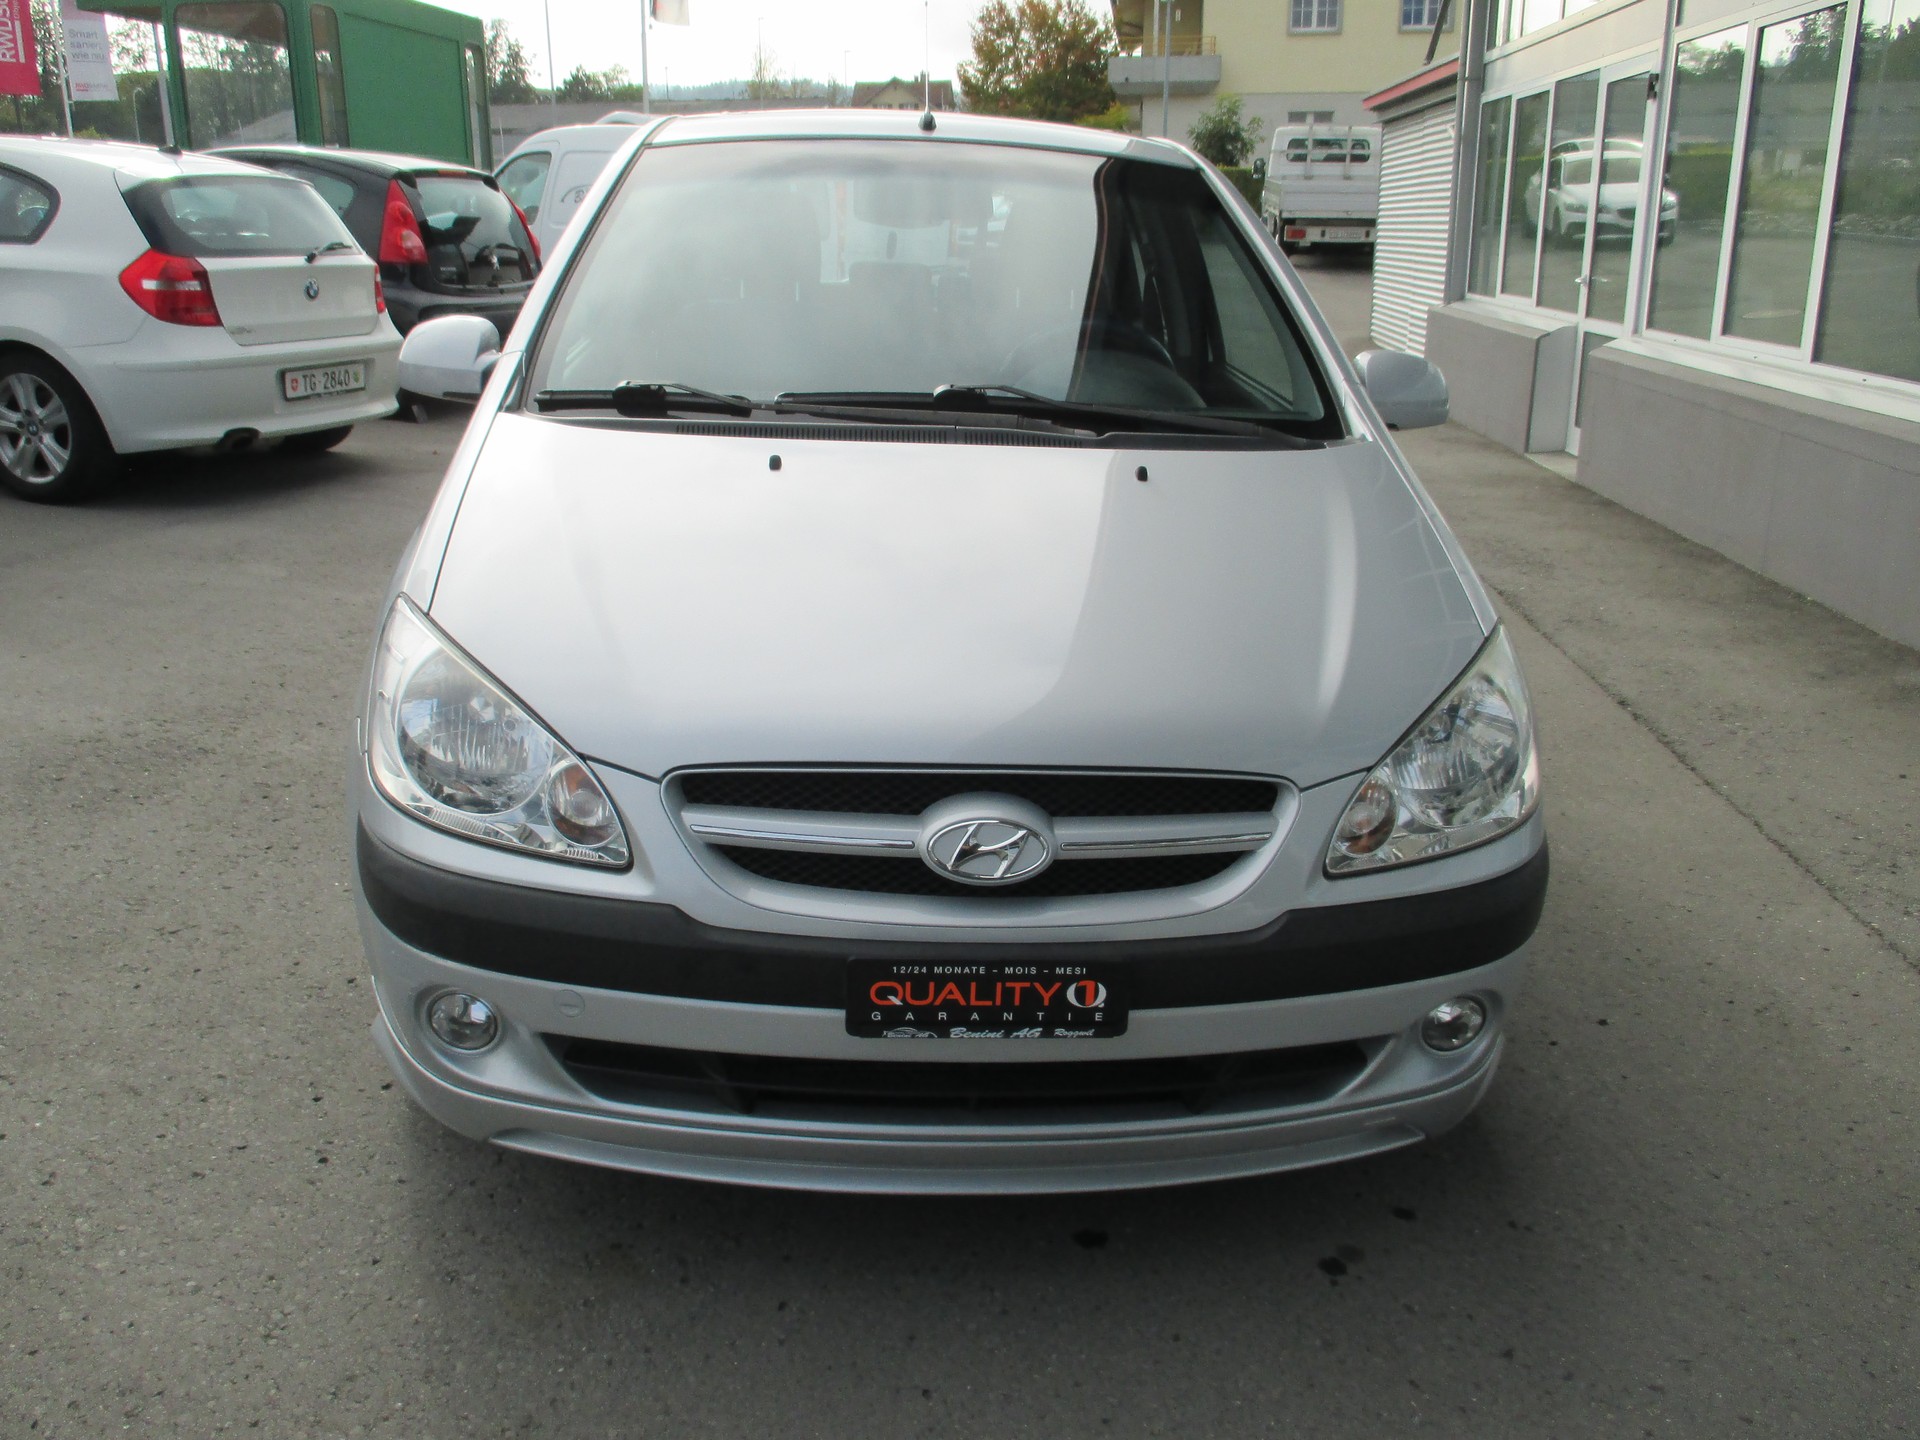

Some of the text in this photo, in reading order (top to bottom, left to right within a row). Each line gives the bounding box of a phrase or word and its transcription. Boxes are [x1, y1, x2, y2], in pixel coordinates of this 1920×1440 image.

[0, 0, 16, 62] RWDS
[68, 28, 98, 39] Smart
[302, 369, 350, 392] TG 2840
[892, 966, 927, 974] 12/24
[934, 966, 986, 974] MONATE
[1004, 966, 1037, 974] MOIS
[1055, 967, 1086, 975] MESI
[869, 981, 1062, 1006] QUALITY
[871, 1012, 1103, 1021] GARANTIE
[949, 1027, 1095, 1038] Benini AG Roggwil
